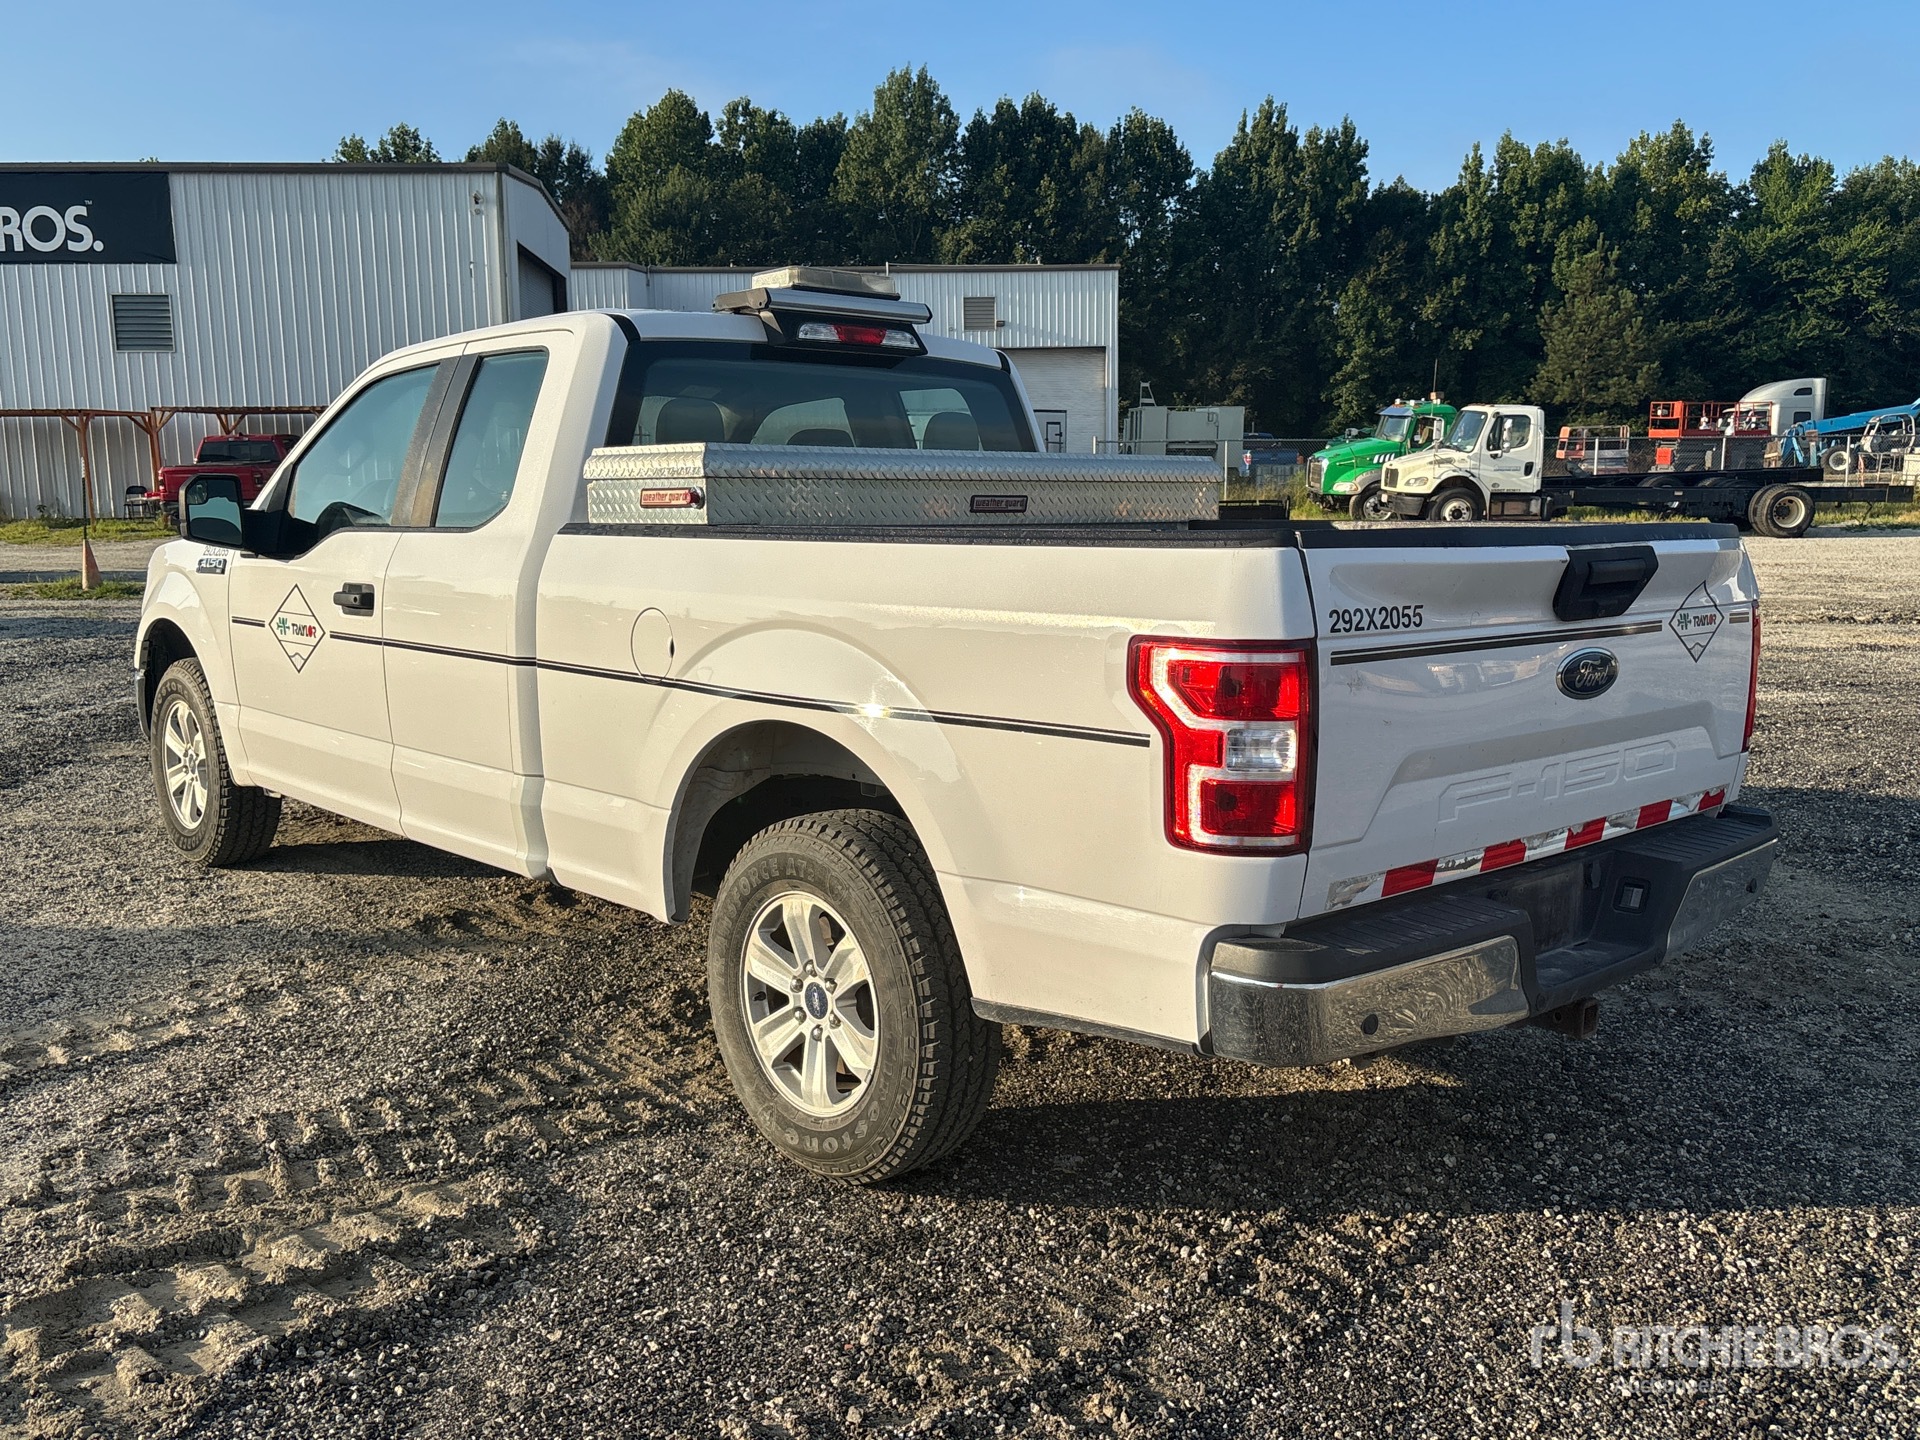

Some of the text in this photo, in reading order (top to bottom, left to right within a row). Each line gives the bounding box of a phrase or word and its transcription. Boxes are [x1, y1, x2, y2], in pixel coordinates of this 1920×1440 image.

[291, 622, 317, 638] TRAYLOR
[1329, 605, 1424, 633] 292X2055
[1693, 614, 1717, 627] TRAYLOR
[1575, 660, 1609, 688] Ford
[1438, 740, 1677, 823] F-150
